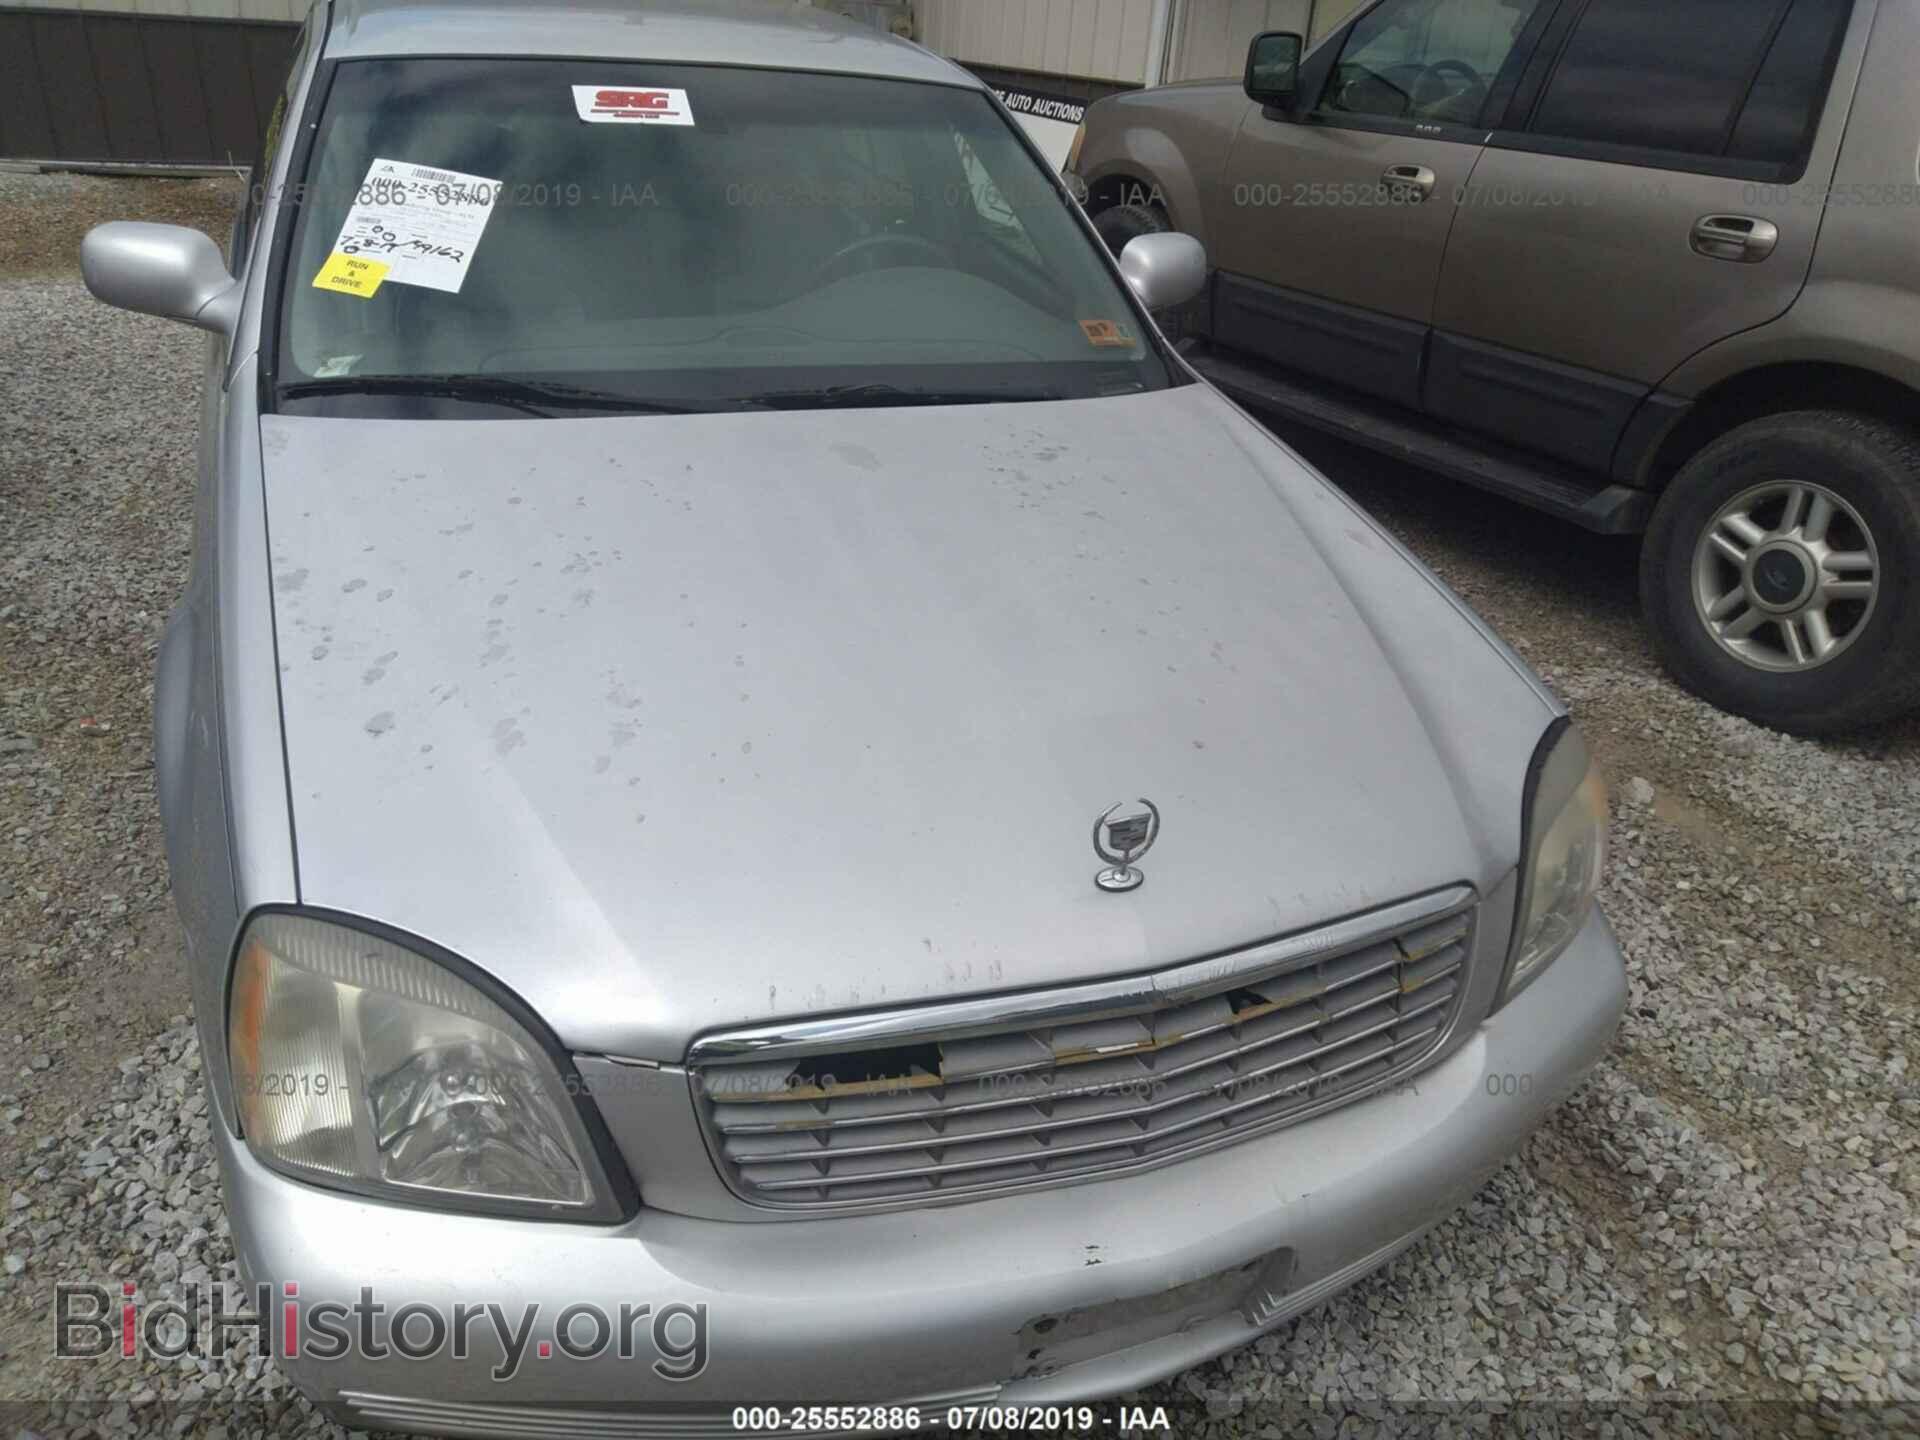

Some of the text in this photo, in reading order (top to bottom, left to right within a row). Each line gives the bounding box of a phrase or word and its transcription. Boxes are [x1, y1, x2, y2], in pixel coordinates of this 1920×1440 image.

[1006, 93, 1032, 111] AUTO
[1031, 98, 1084, 122] AUCTIONS
[346, 260, 369, 270] RUN
[331, 276, 363, 288] DRIVE
